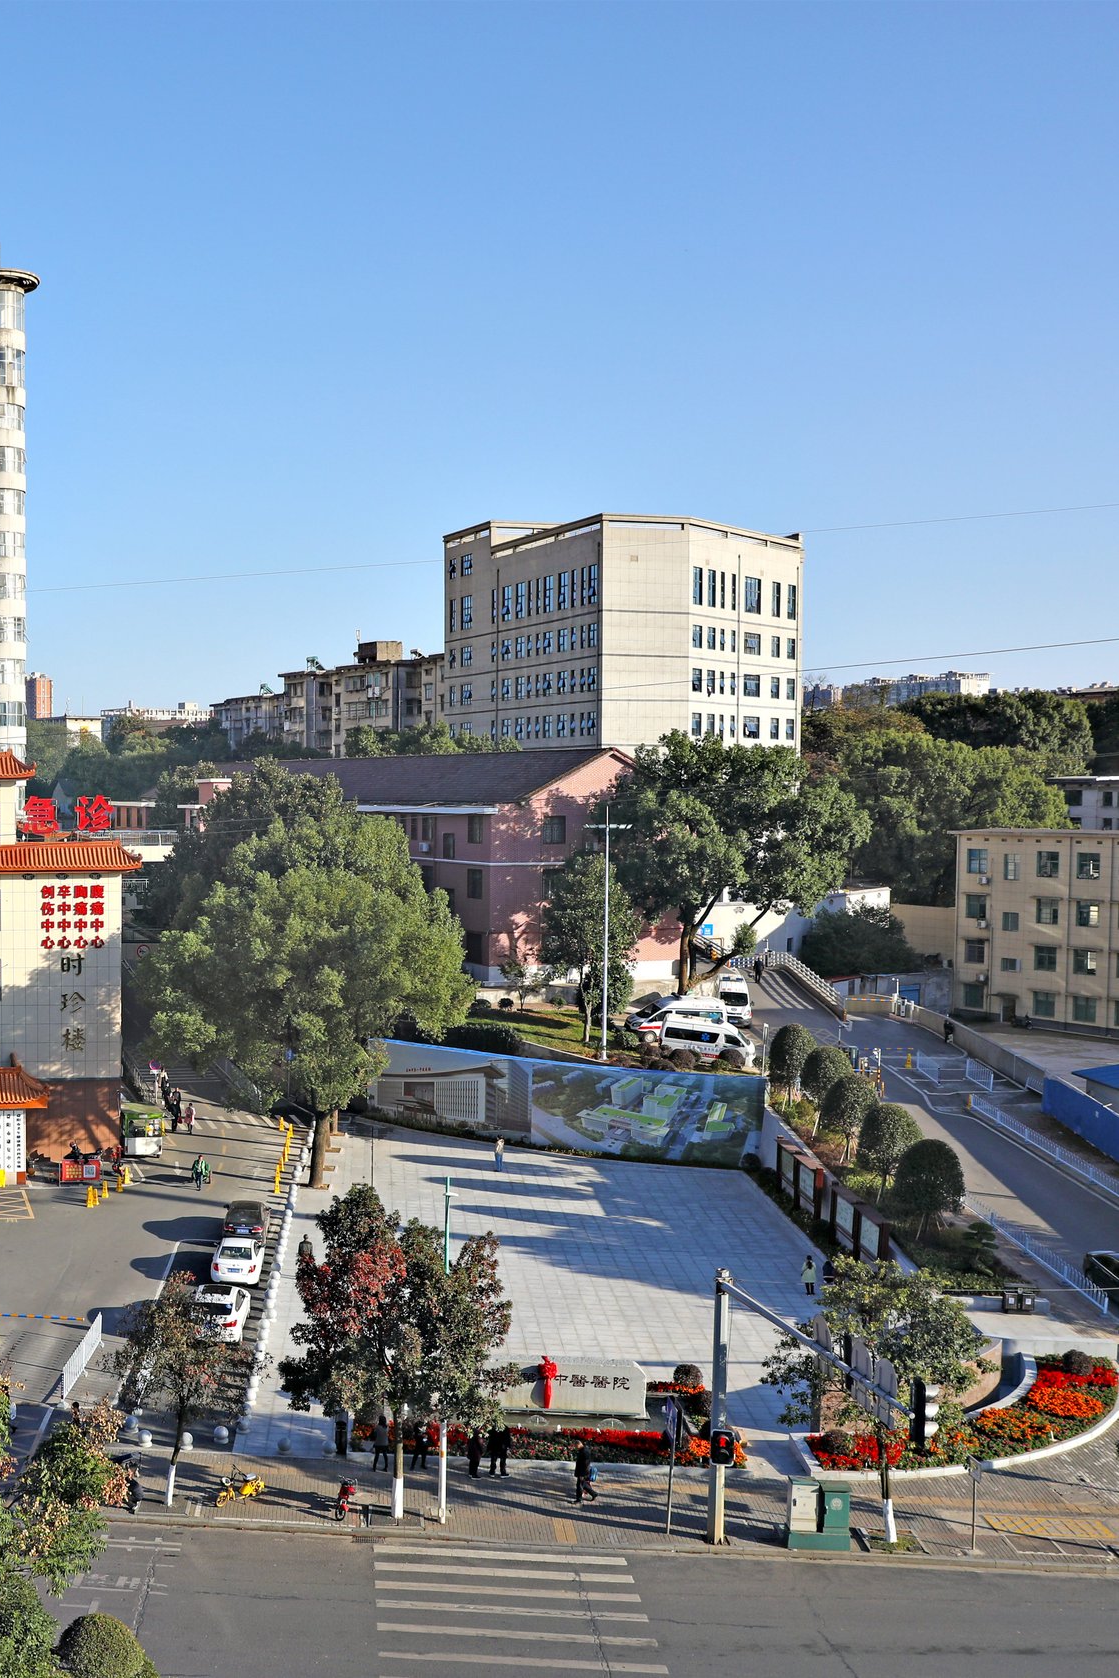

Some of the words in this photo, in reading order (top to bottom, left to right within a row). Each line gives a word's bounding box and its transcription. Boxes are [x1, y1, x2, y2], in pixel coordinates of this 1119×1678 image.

[22, 795, 115, 832] 急诊
[40, 885, 55, 949] 创伤中心
[57, 885, 71, 949] 卒中中心
[73, 885, 88, 949] 胸痛中心
[60, 953, 86, 1052] 时珍楼
